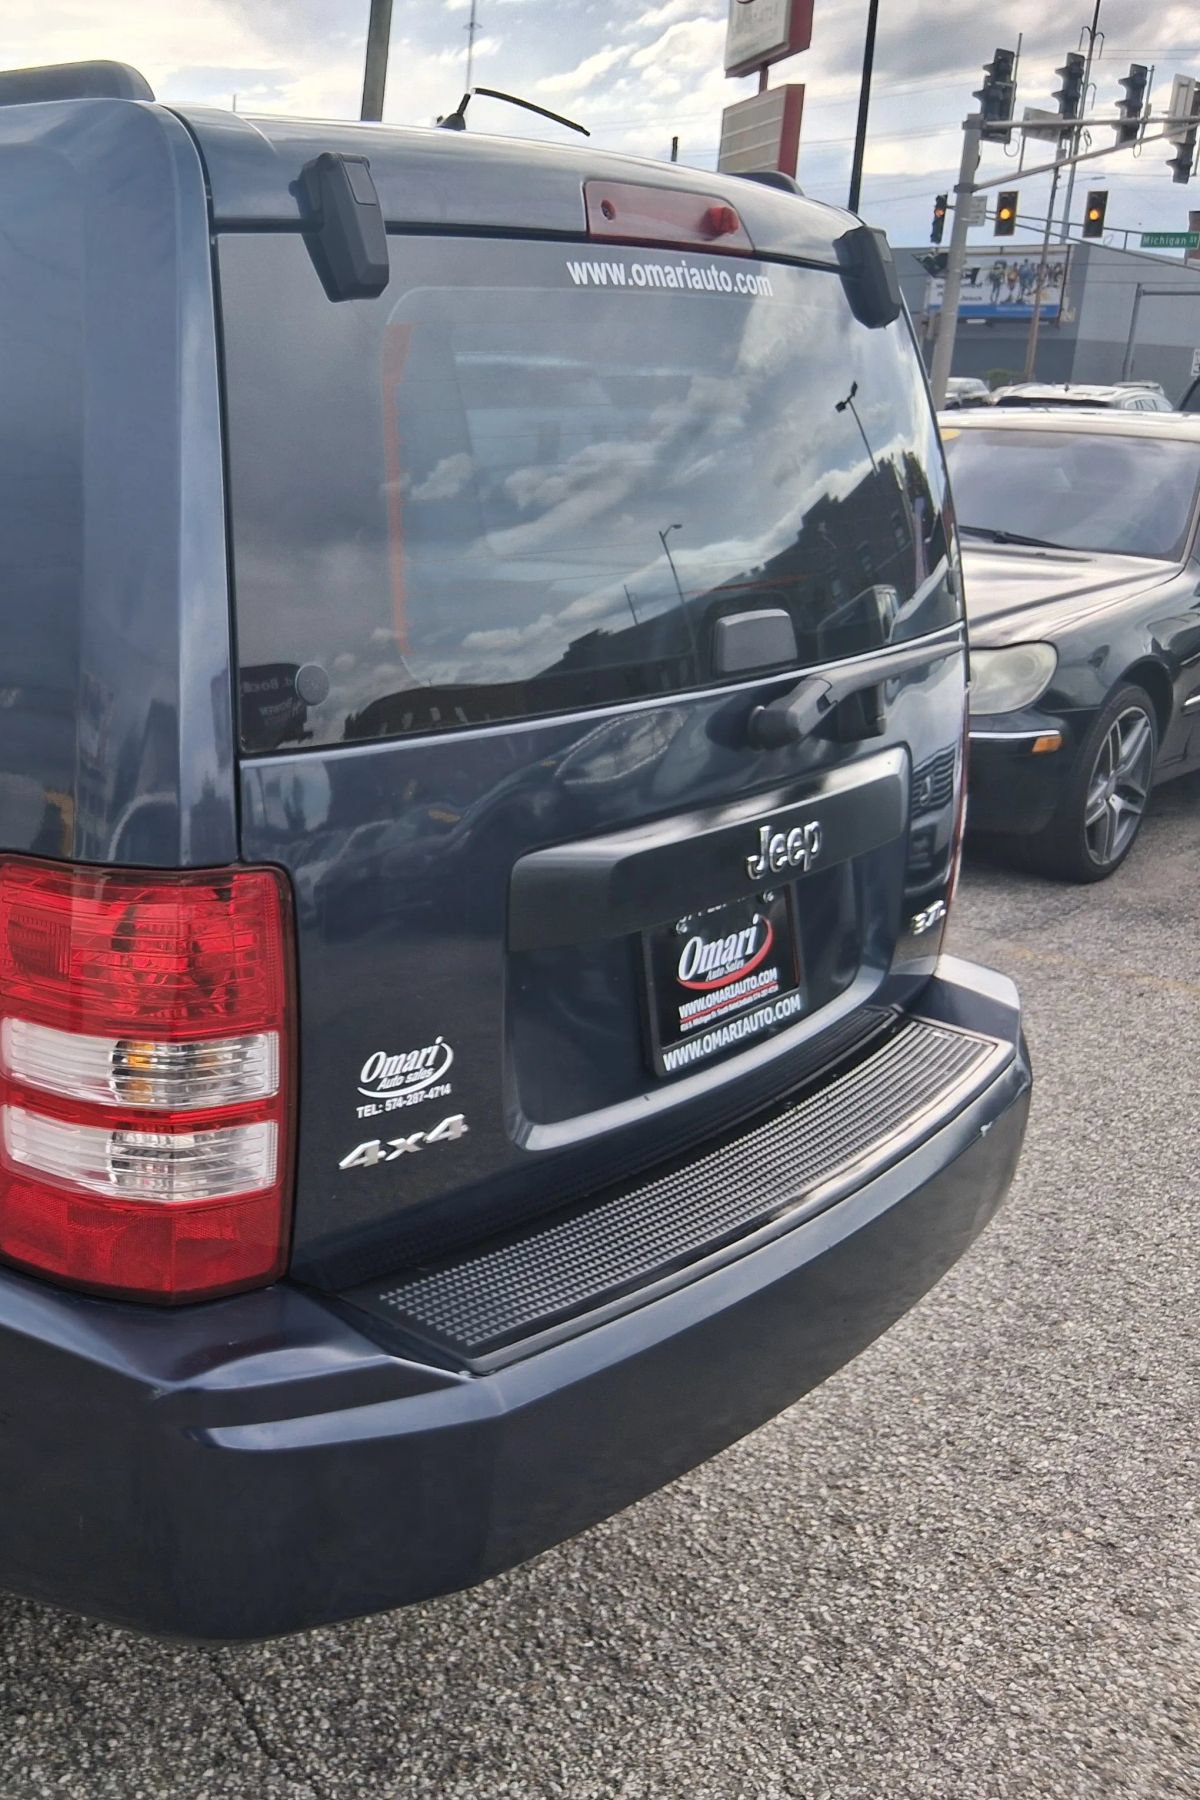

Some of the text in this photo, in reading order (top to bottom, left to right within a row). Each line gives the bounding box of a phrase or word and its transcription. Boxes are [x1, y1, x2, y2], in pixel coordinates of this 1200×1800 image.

[1143, 235, 1187, 246] Michigan
[566, 260, 774, 297] www.omariauto.com
[746, 821, 822, 880] Jeep
[678, 912, 761, 981] Omari
[678, 967, 778, 1020] WWW.OMARIAUTO.COM
[705, 965, 724, 983] Auto
[662, 993, 802, 1073] WWW.OMARIAUTO.COM
[360, 1035, 444, 1083] Omari
[376, 1075, 404, 1091] Auto
[356, 1083, 452, 1118] TEL: 574-287-4714
[338, 1113, 469, 1169] 4x4
